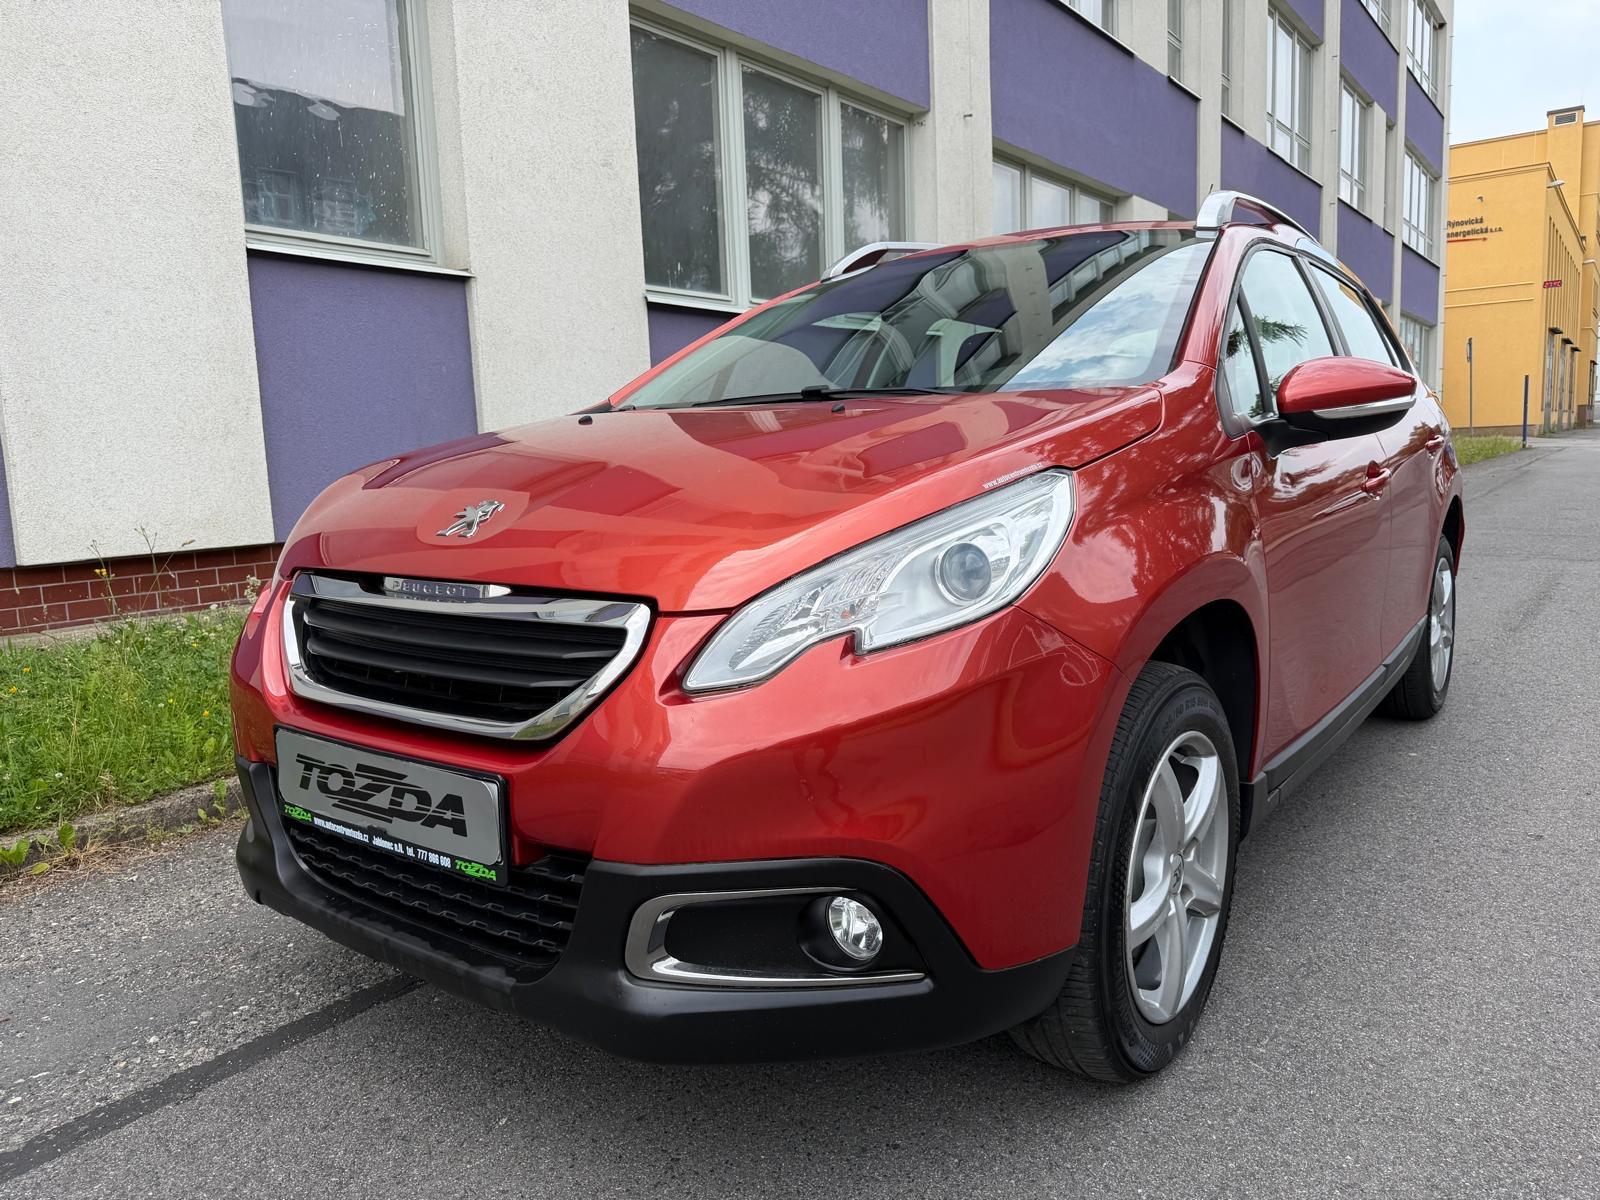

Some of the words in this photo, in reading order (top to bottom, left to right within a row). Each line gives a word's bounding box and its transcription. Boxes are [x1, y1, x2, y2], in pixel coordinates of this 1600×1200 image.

[391, 580, 467, 597] PEUGEOT
[296, 753, 468, 838] TOZDA
[284, 804, 312, 823] TOZDA
[372, 835, 394, 851] Jablonec
[416, 848, 428, 861] 777
[455, 859, 497, 882] TOZDA
